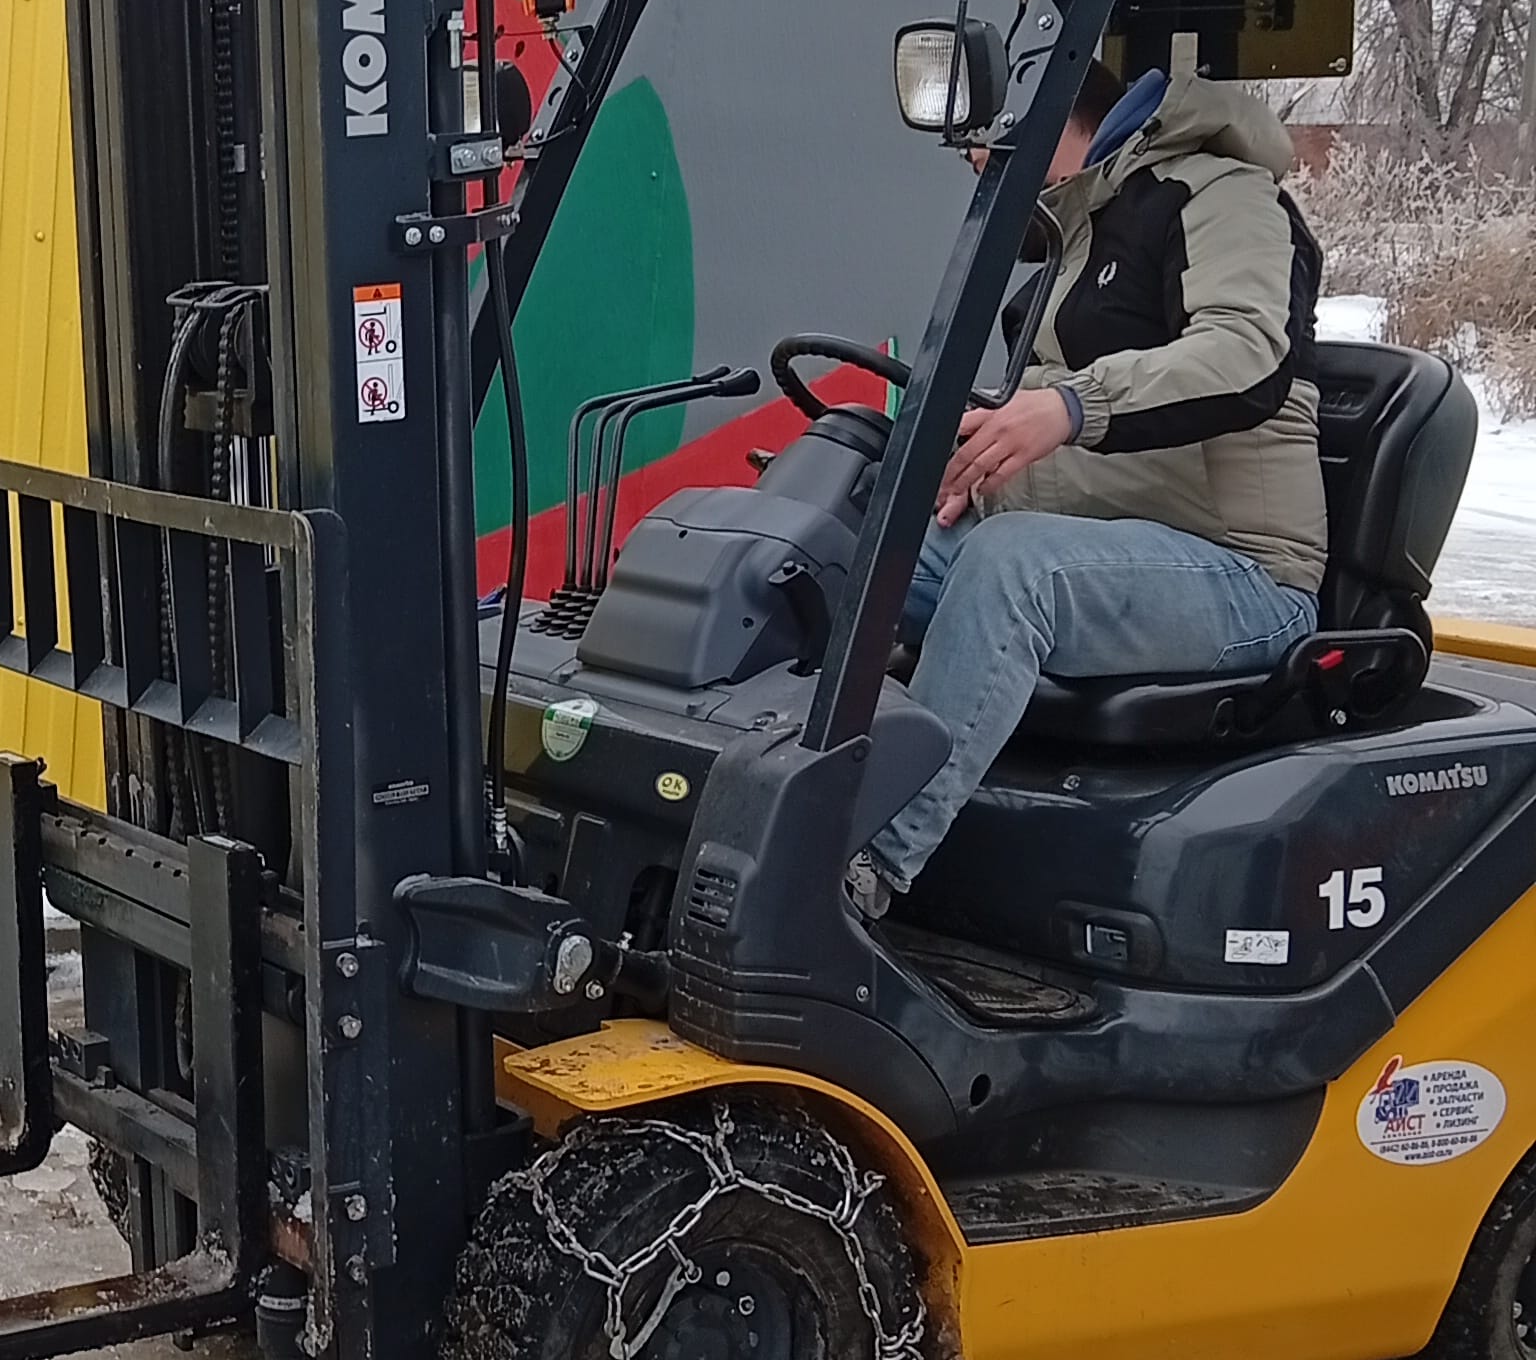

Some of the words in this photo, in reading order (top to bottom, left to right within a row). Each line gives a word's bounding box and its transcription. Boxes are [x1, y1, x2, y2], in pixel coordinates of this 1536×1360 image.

[1386, 762, 1488, 796] KOMATSU
[1318, 866, 1386, 930] 15
[1430, 1070, 1467, 1082] АРЕНДА
[1432, 1080, 1479, 1094] ПРОДАЖА
[1436, 1092, 1484, 1105] ЗАПЧАСТИ
[1439, 1104, 1474, 1117] СЕРВИС
[1384, 1114, 1426, 1133] АИСТ
[1442, 1116, 1479, 1129] ЛИЗИНГ
